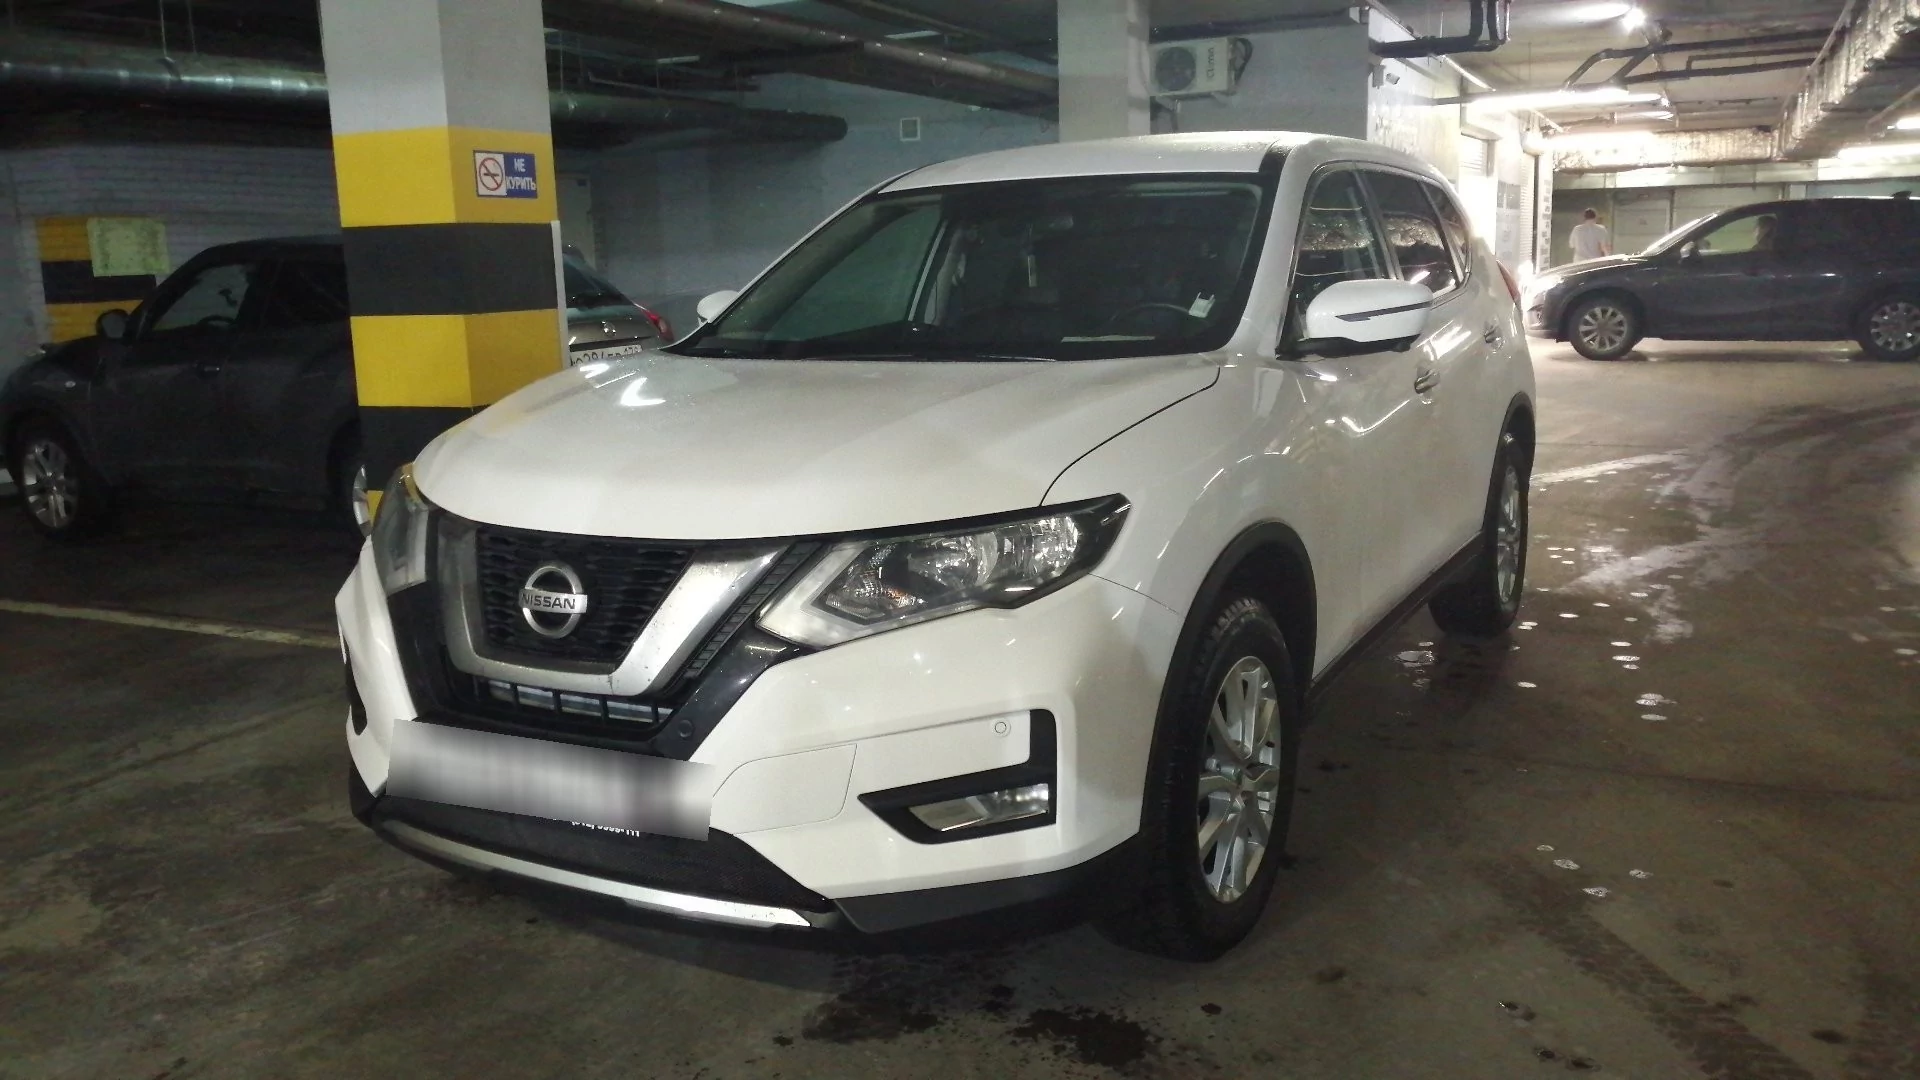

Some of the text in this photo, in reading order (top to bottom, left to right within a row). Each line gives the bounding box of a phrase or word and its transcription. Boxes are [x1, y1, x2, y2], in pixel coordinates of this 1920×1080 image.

[513, 158, 526, 172] НЕ
[505, 176, 537, 190] КУРИТЬ
[522, 593, 576, 610] NISSAN
